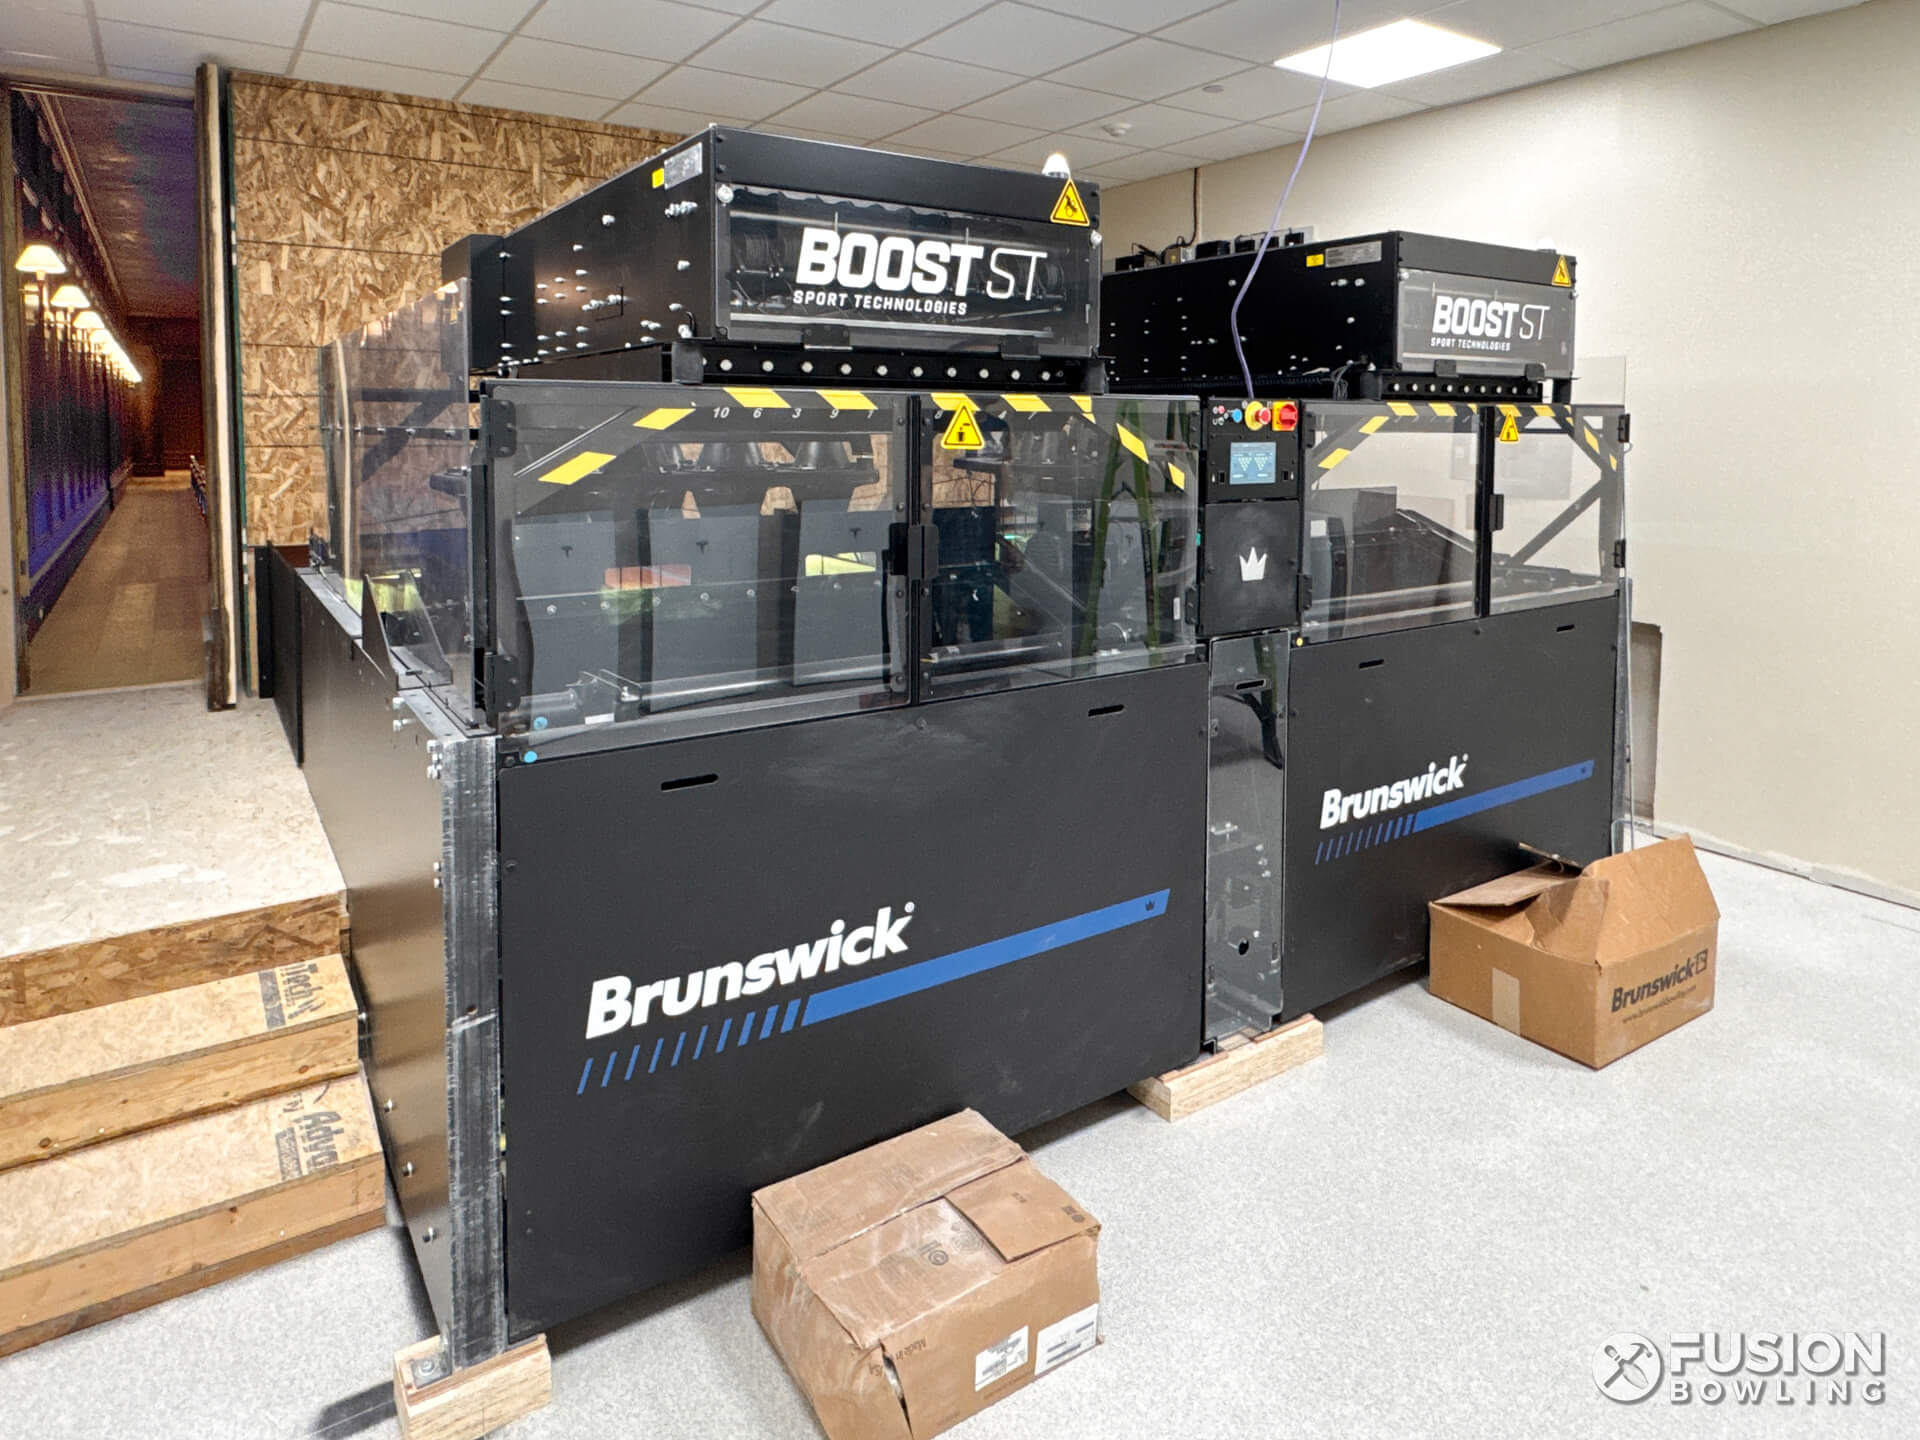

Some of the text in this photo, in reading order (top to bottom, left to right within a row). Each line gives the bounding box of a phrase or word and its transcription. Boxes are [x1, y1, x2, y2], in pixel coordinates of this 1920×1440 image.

[796, 227, 1048, 301] BOOST ST
[793, 290, 967, 316] SPORT TECHNOLOGIES
[1432, 295, 1550, 340] BOOST ST
[1430, 337, 1511, 352] SPORT TECHNOLOGIES
[713, 407, 730, 418] 10
[753, 407, 762, 419] 6
[792, 408, 801, 419] 3
[1319, 755, 1465, 829] Brunswick
[585, 905, 908, 1039] Brunswick
[1611, 957, 1693, 1013] Brunswick
